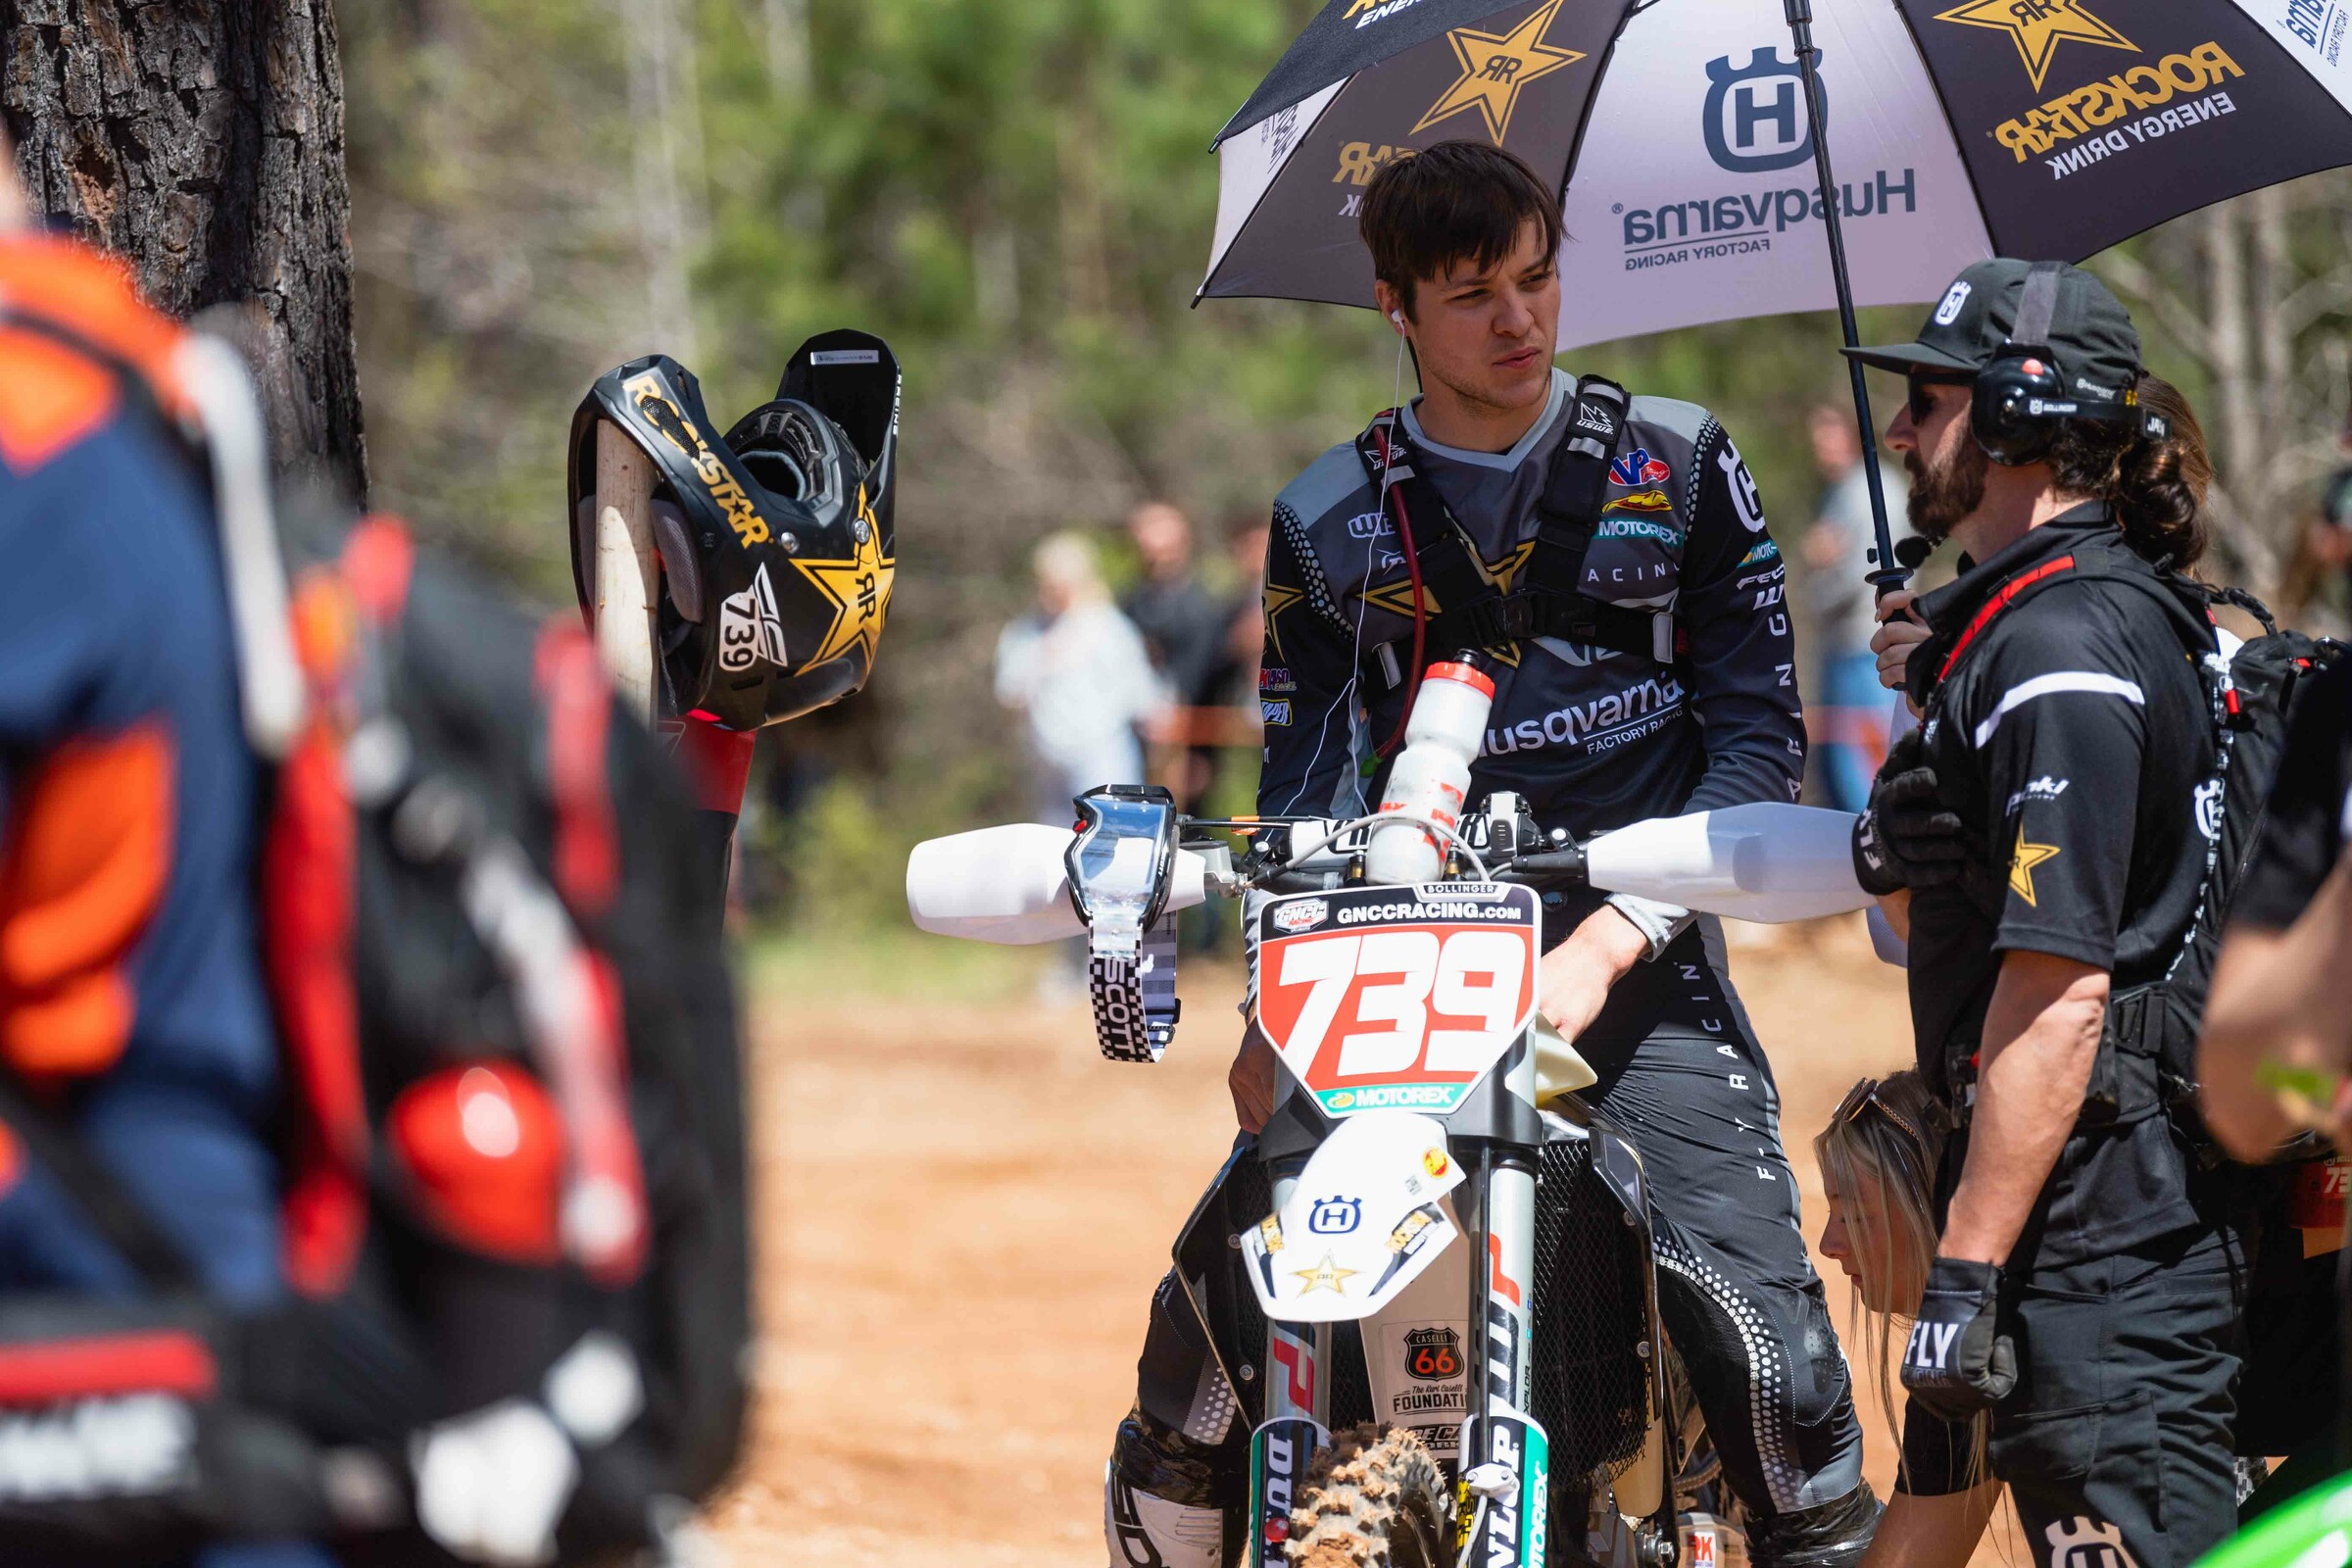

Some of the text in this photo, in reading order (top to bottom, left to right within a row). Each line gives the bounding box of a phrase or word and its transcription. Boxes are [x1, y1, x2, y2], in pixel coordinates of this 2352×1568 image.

[1612, 448, 1650, 485] VP
[1598, 520, 1679, 546] MOTOREX
[1587, 563, 1680, 583] ACIN
[722, 597, 756, 668] 739
[1587, 724, 1646, 756] FACTORY
[1427, 885, 1494, 894] BOLLINGER
[1103, 958, 1135, 1055] SCOTT
[1279, 931, 1526, 1079] 739
[1674, 961, 1750, 1091] RACIN
[1355, 1087, 1452, 1107] MOTOREX
[1415, 1334, 1447, 1345] CASELLI
[1904, 1319, 1960, 1369] FLY
[1415, 1348, 1456, 1374] 66
[1393, 1393, 1467, 1412] FOUNDATI
[1412, 1385, 1425, 1394] The
